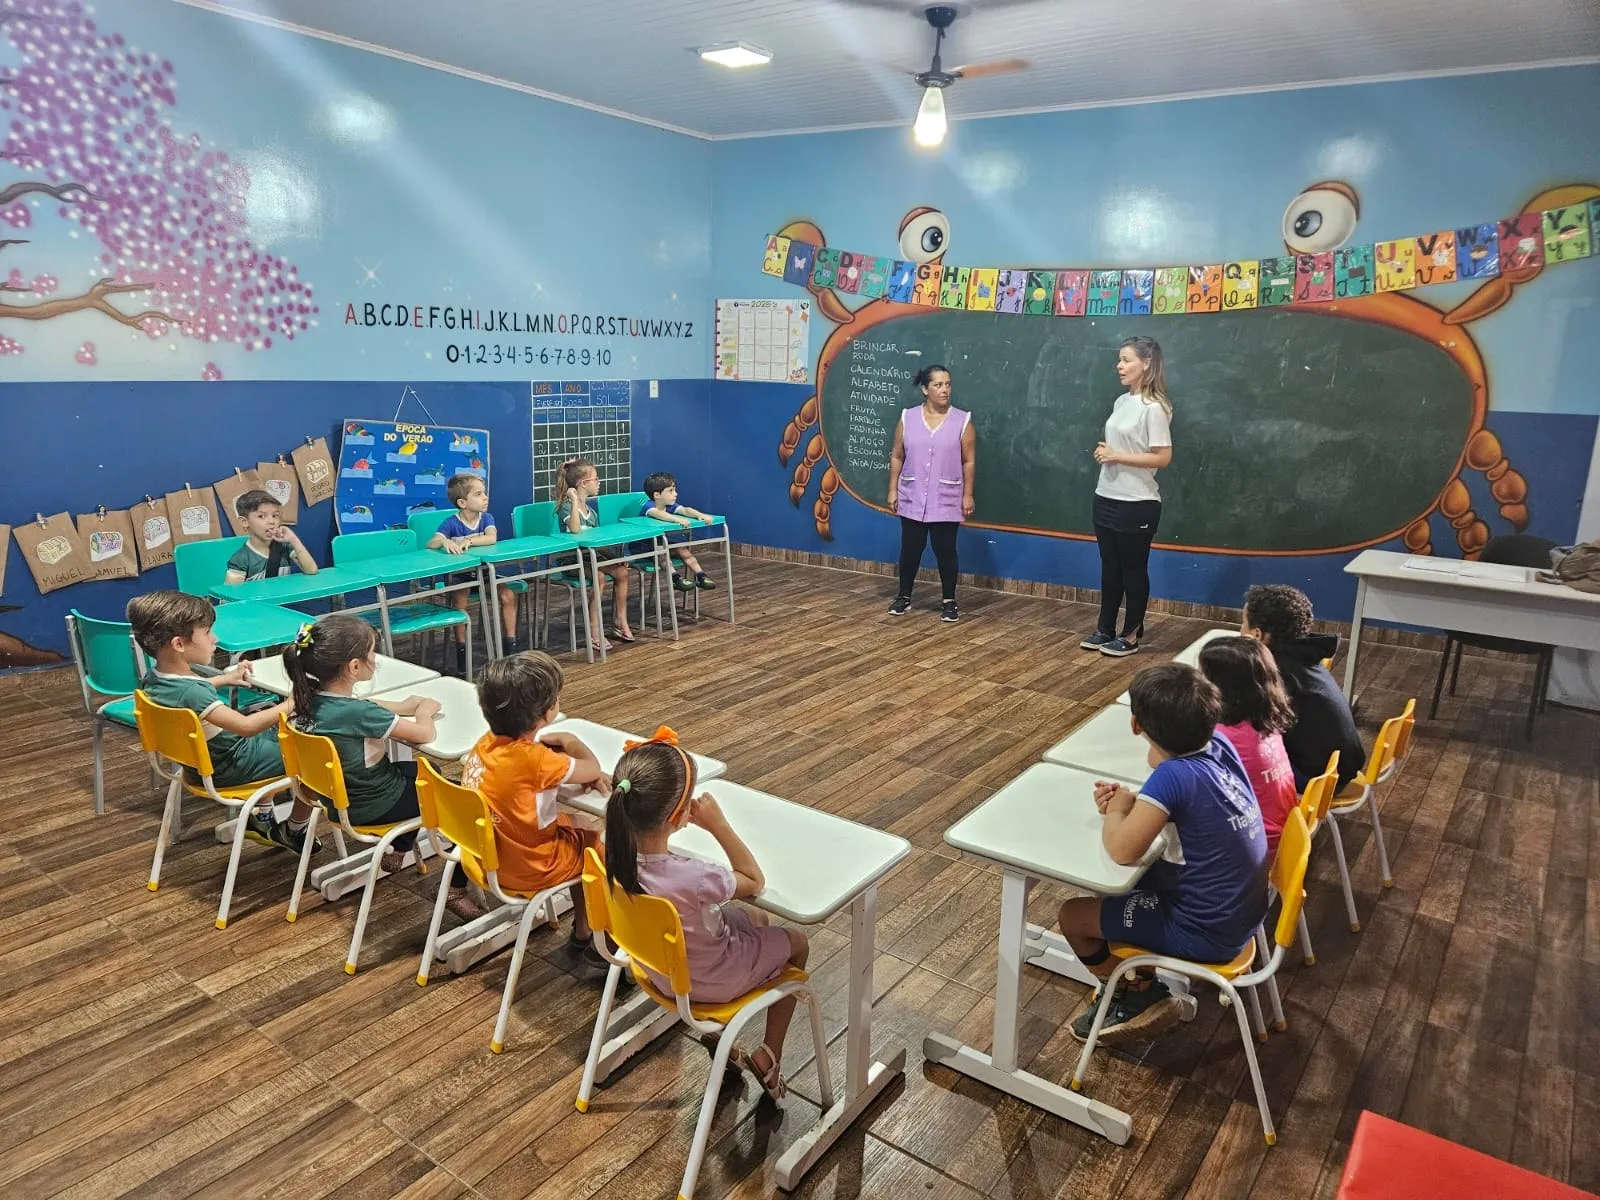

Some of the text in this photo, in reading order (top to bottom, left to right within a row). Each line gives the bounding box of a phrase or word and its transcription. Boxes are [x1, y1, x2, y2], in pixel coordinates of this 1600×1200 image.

[1546, 208, 1568, 230] Y
[1501, 218, 1522, 239] X
[768, 237, 778, 252] A
[1417, 234, 1438, 256] V
[1456, 226, 1478, 248] W
[817, 249, 828, 263] C
[840, 252, 854, 268] D
[1335, 250, 1356, 268] T
[1376, 243, 1412, 263] U u
[892, 260, 904, 276] F
[918, 264, 940, 280] G g
[1225, 263, 1256, 280] Q q
[1300, 255, 1315, 274] S
[944, 266, 968, 283] H h
[999, 270, 1012, 286] J
[1028, 272, 1043, 288] K
[1213, 274, 1220, 282] p
[1360, 276, 1370, 294] t
[1189, 293, 1218, 310] P p
[1261, 287, 1272, 304] R
[1025, 298, 1035, 314] K
[1088, 298, 1117, 314] M m
[1120, 298, 1148, 314] N n
[854, 339, 899, 354] BRINCAR
[853, 352, 876, 361] RODA
[850, 364, 911, 380] CALENDÁRIO
[851, 376, 900, 394] ALFABETO
[850, 390, 896, 406] ATIVIDADE
[850, 404, 876, 416] FRUTA
[384, 432, 397, 442] DO
[849, 434, 884, 447] ALMOÇO
[554, 442, 560, 454] 3
[568, 437, 576, 452] 4
[584, 440, 590, 452] 5
[848, 445, 884, 458] ESCOVAR
[42, 569, 85, 586] MIGUEL
[96, 567, 130, 579] AMUEL
